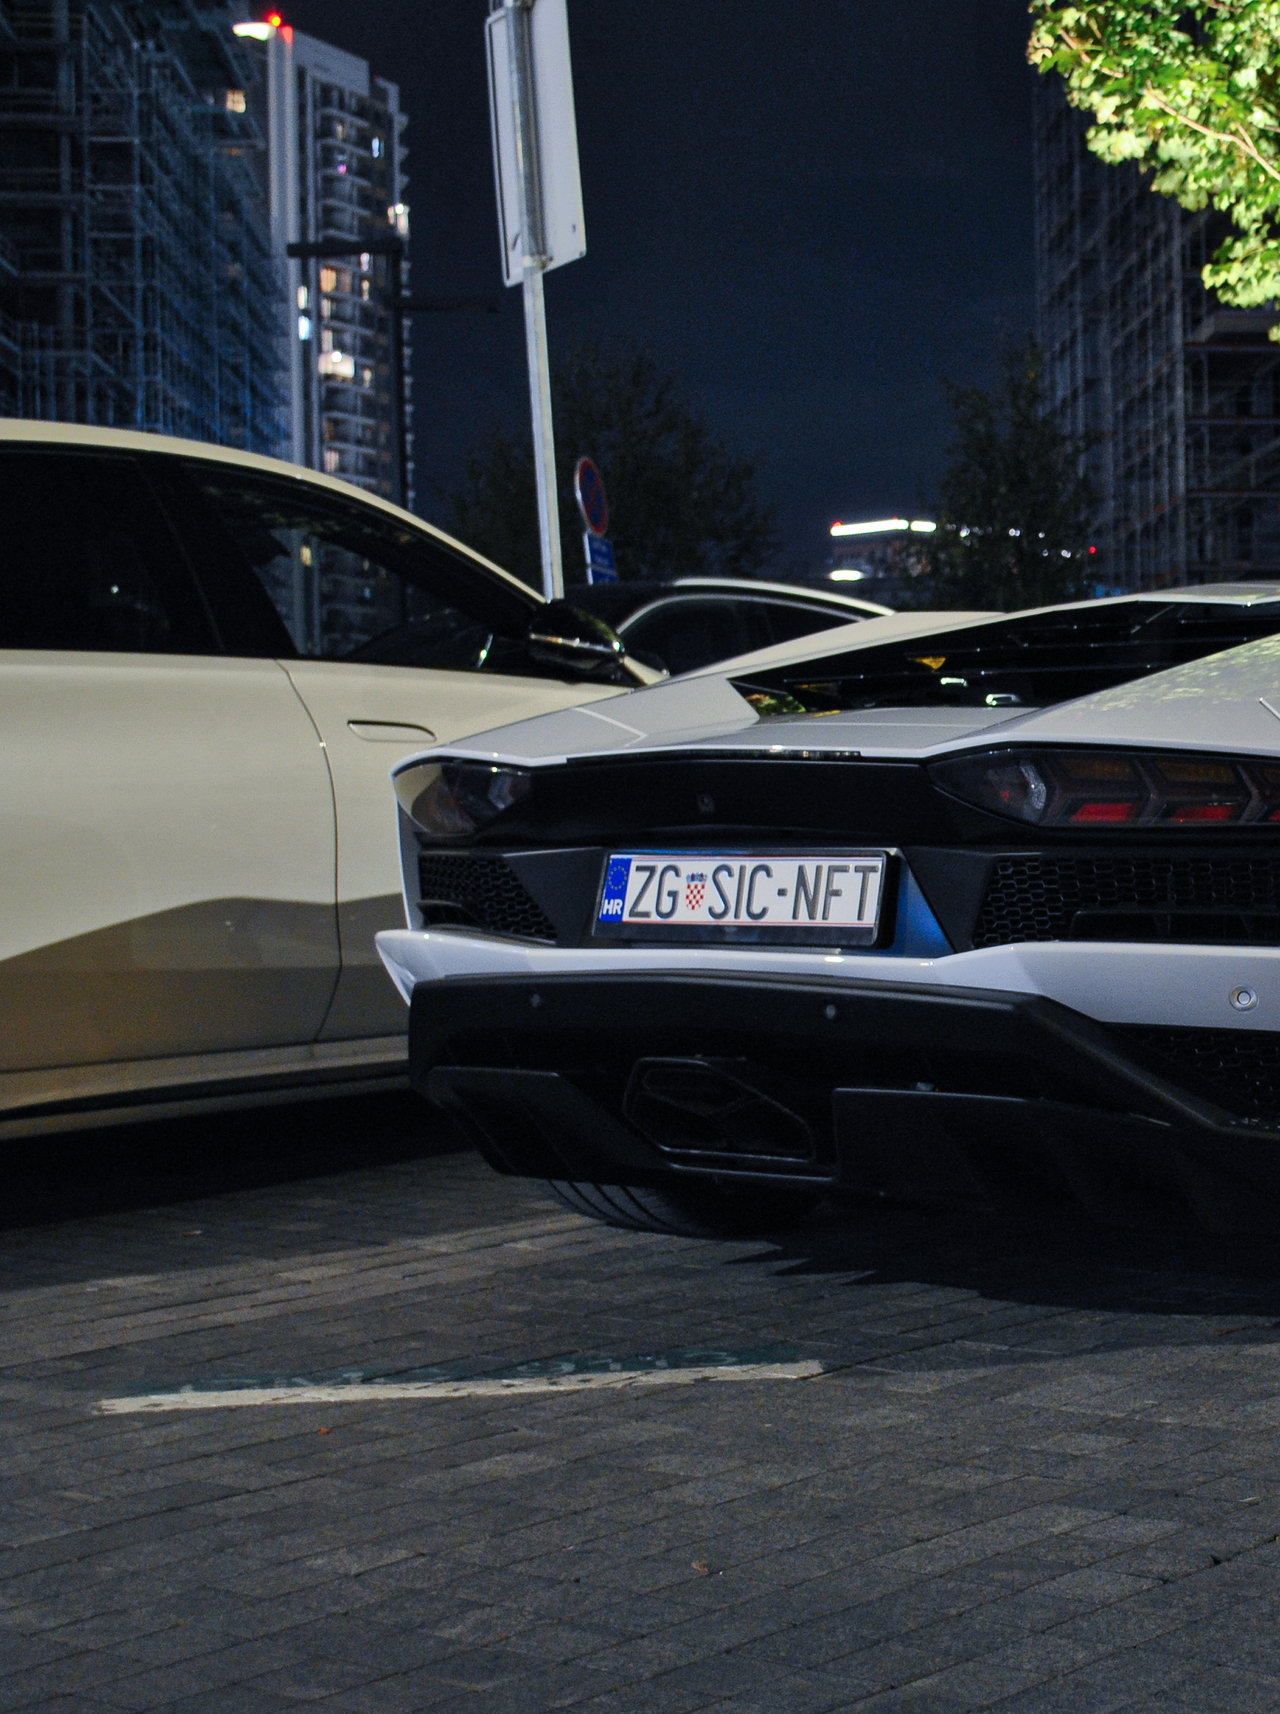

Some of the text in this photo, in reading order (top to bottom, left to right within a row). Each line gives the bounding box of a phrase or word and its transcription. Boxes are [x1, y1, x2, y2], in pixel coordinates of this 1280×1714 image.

[603, 898, 623, 915] HR
[628, 864, 879, 921] ZG SIC-NFT
